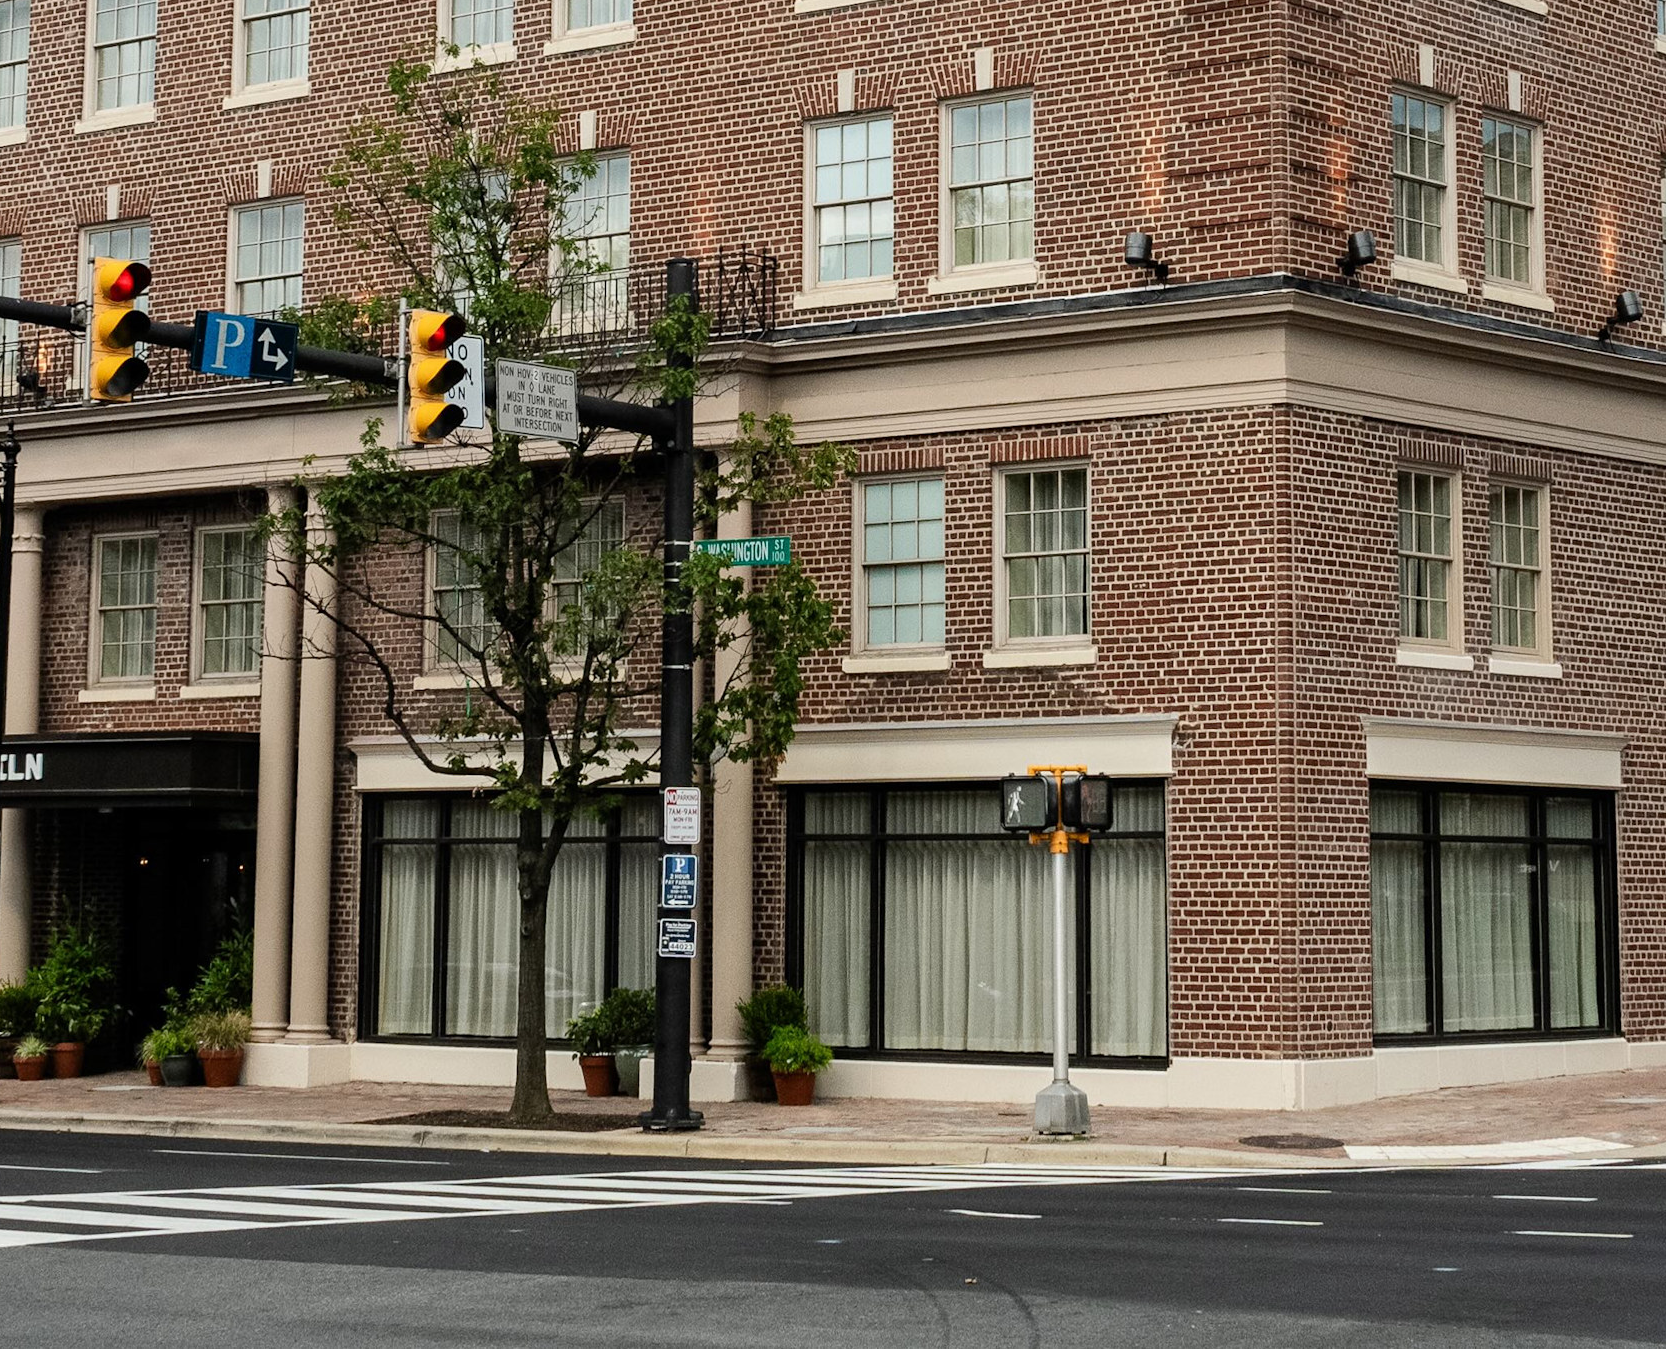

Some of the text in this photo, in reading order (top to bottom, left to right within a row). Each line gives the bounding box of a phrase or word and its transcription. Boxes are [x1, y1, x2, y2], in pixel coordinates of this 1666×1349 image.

[211, 318, 245, 369] P
[499, 364, 574, 387] NON HOV-2 VEHICLES
[448, 386, 466, 400] ON
[518, 381, 556, 396] IN LANE
[527, 394, 546, 406] TURN
[549, 397, 568, 409] RIGHT
[502, 403, 573, 422] AT OR BEFORE NEXT
[514, 417, 563, 433] INTERSECTION
[774, 539, 785, 551] ST
[772, 551, 786, 562] 100
[667, 791, 676, 803] NO
[674, 857, 686, 873] P
